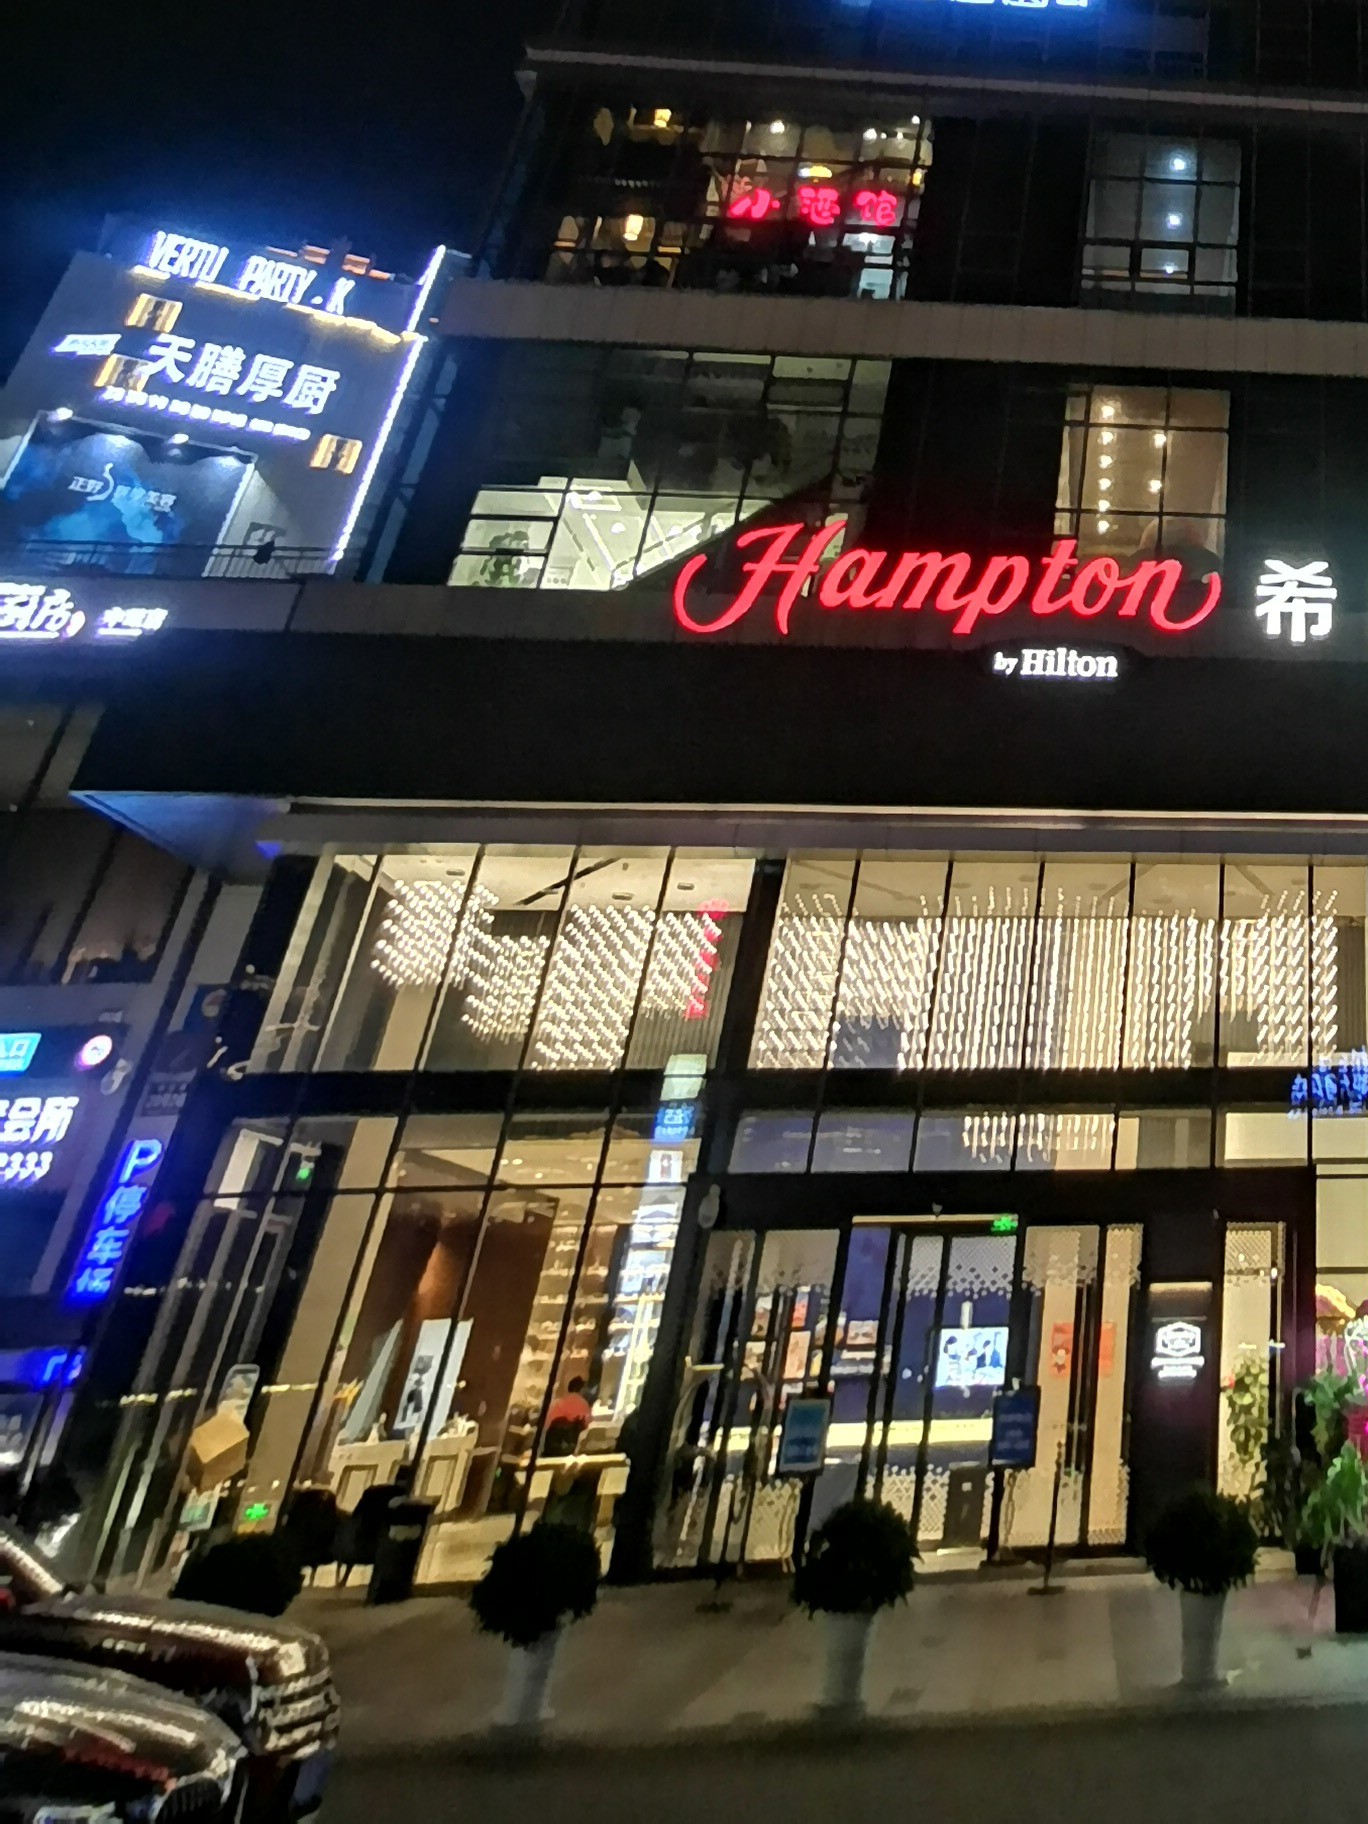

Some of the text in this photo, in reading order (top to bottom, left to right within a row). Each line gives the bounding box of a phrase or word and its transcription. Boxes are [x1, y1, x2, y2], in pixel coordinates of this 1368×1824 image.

[149, 230, 230, 282] VERTU
[672, 521, 1222, 635] Hampton
[993, 647, 1118, 677] by Hilton
[0, 1096, 79, 1144] 会所
[118, 1138, 163, 1184] P
[76, 1184, 148, 1294] 停车场
